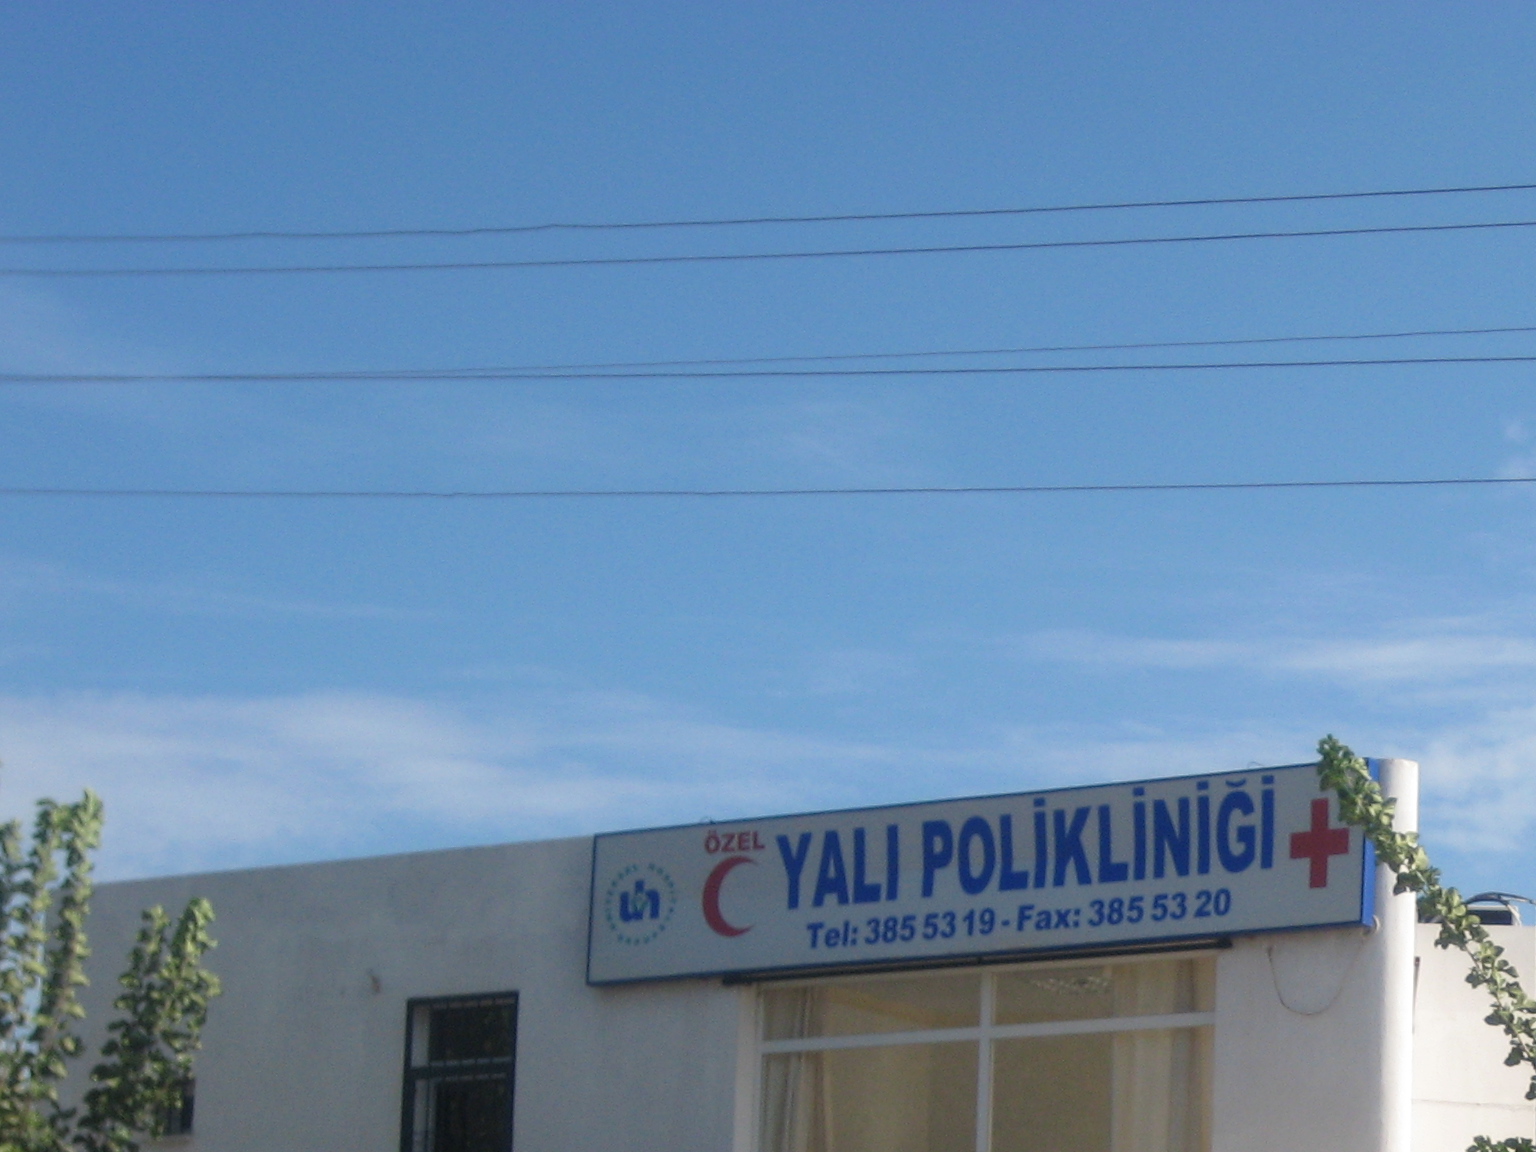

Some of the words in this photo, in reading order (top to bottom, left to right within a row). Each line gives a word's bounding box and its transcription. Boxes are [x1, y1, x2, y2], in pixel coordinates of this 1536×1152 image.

[704, 829, 766, 855] ÖZEL
[775, 824, 899, 910] YALI
[920, 774, 1275, 899] POLİKLİNİĞİ
[807, 920, 858, 949] Tel:
[864, 914, 917, 945] 385
[922, 911, 956, 939] 53
[963, 907, 995, 936] 19
[1017, 903, 1080, 932] Fax:
[1088, 896, 1144, 927] 385
[1151, 891, 1188, 922] 53
[1194, 887, 1231, 919] 20
